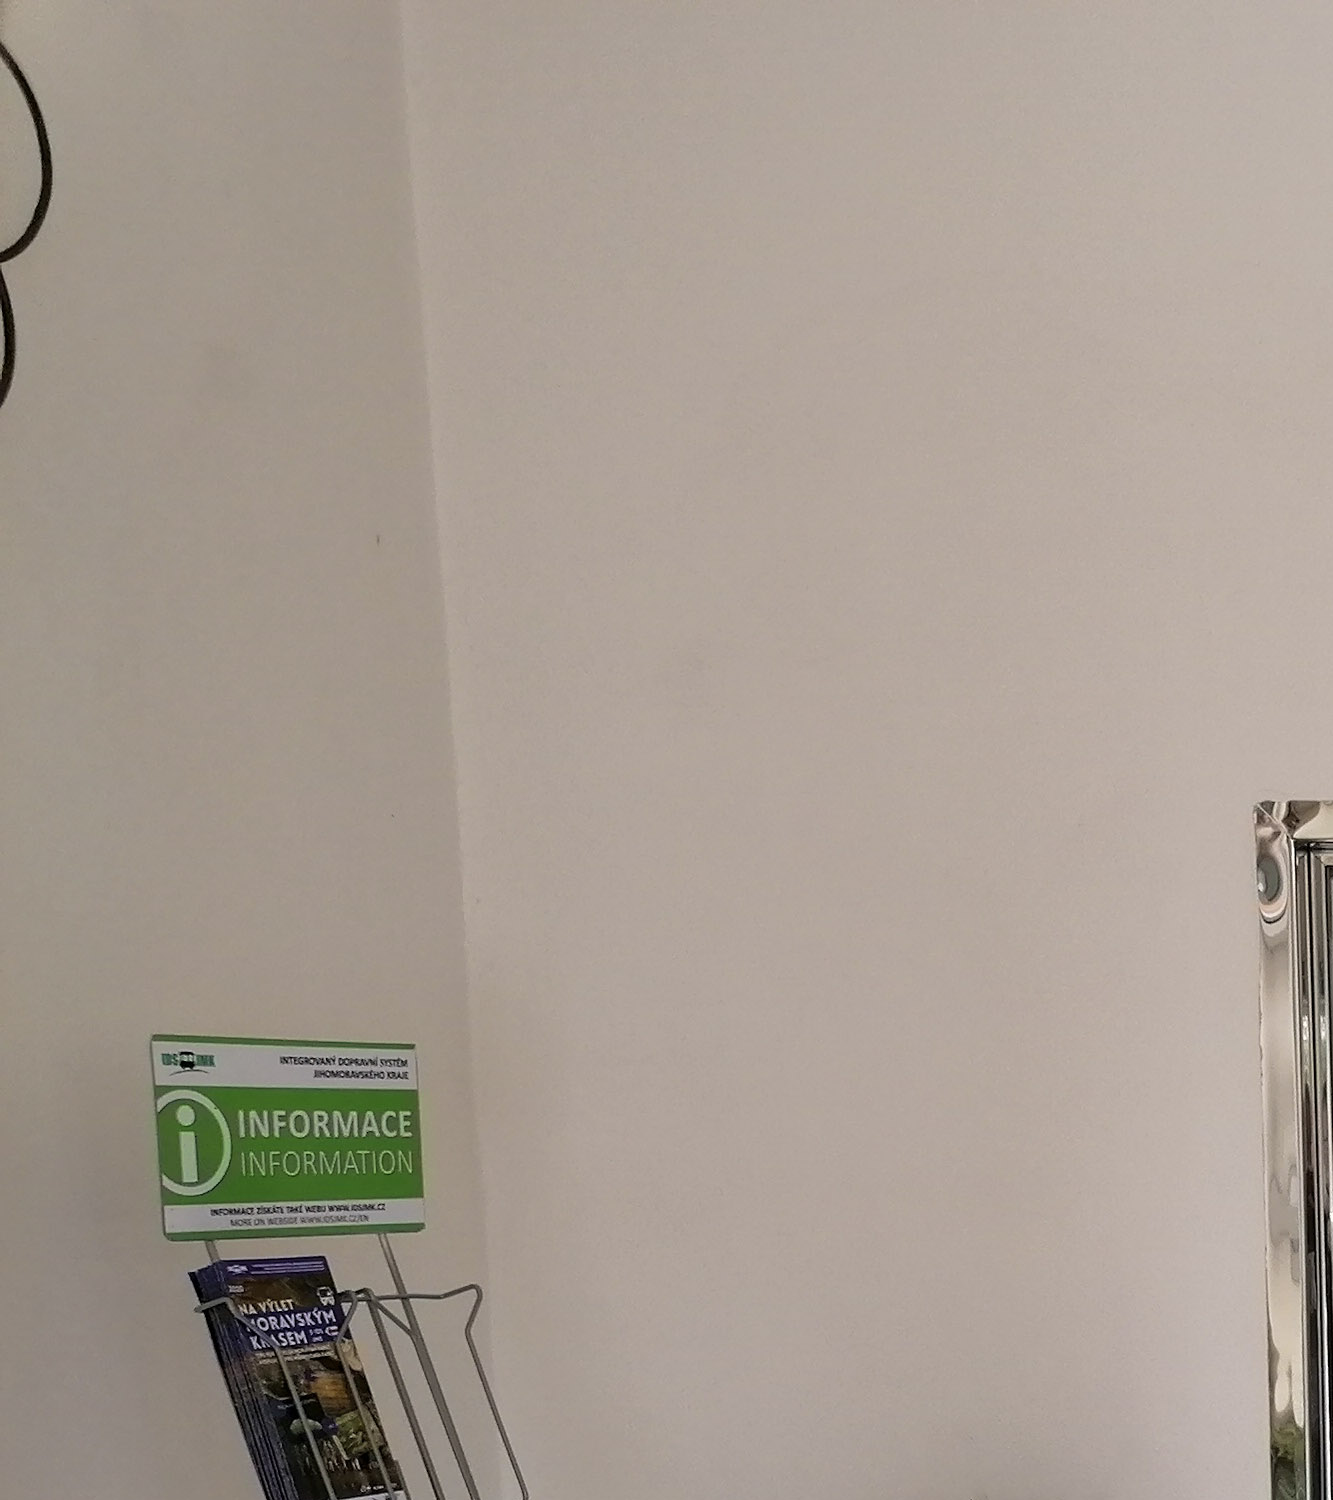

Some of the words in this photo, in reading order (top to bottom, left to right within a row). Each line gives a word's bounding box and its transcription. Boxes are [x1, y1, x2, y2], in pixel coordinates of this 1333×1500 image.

[238, 1109, 413, 1138] INFORMACE
[241, 1150, 413, 1177] INFORMATION
[210, 1207, 254, 1216] INFORMACE
[239, 1303, 258, 1316] NA
[258, 1299, 295, 1314] VÝLET
